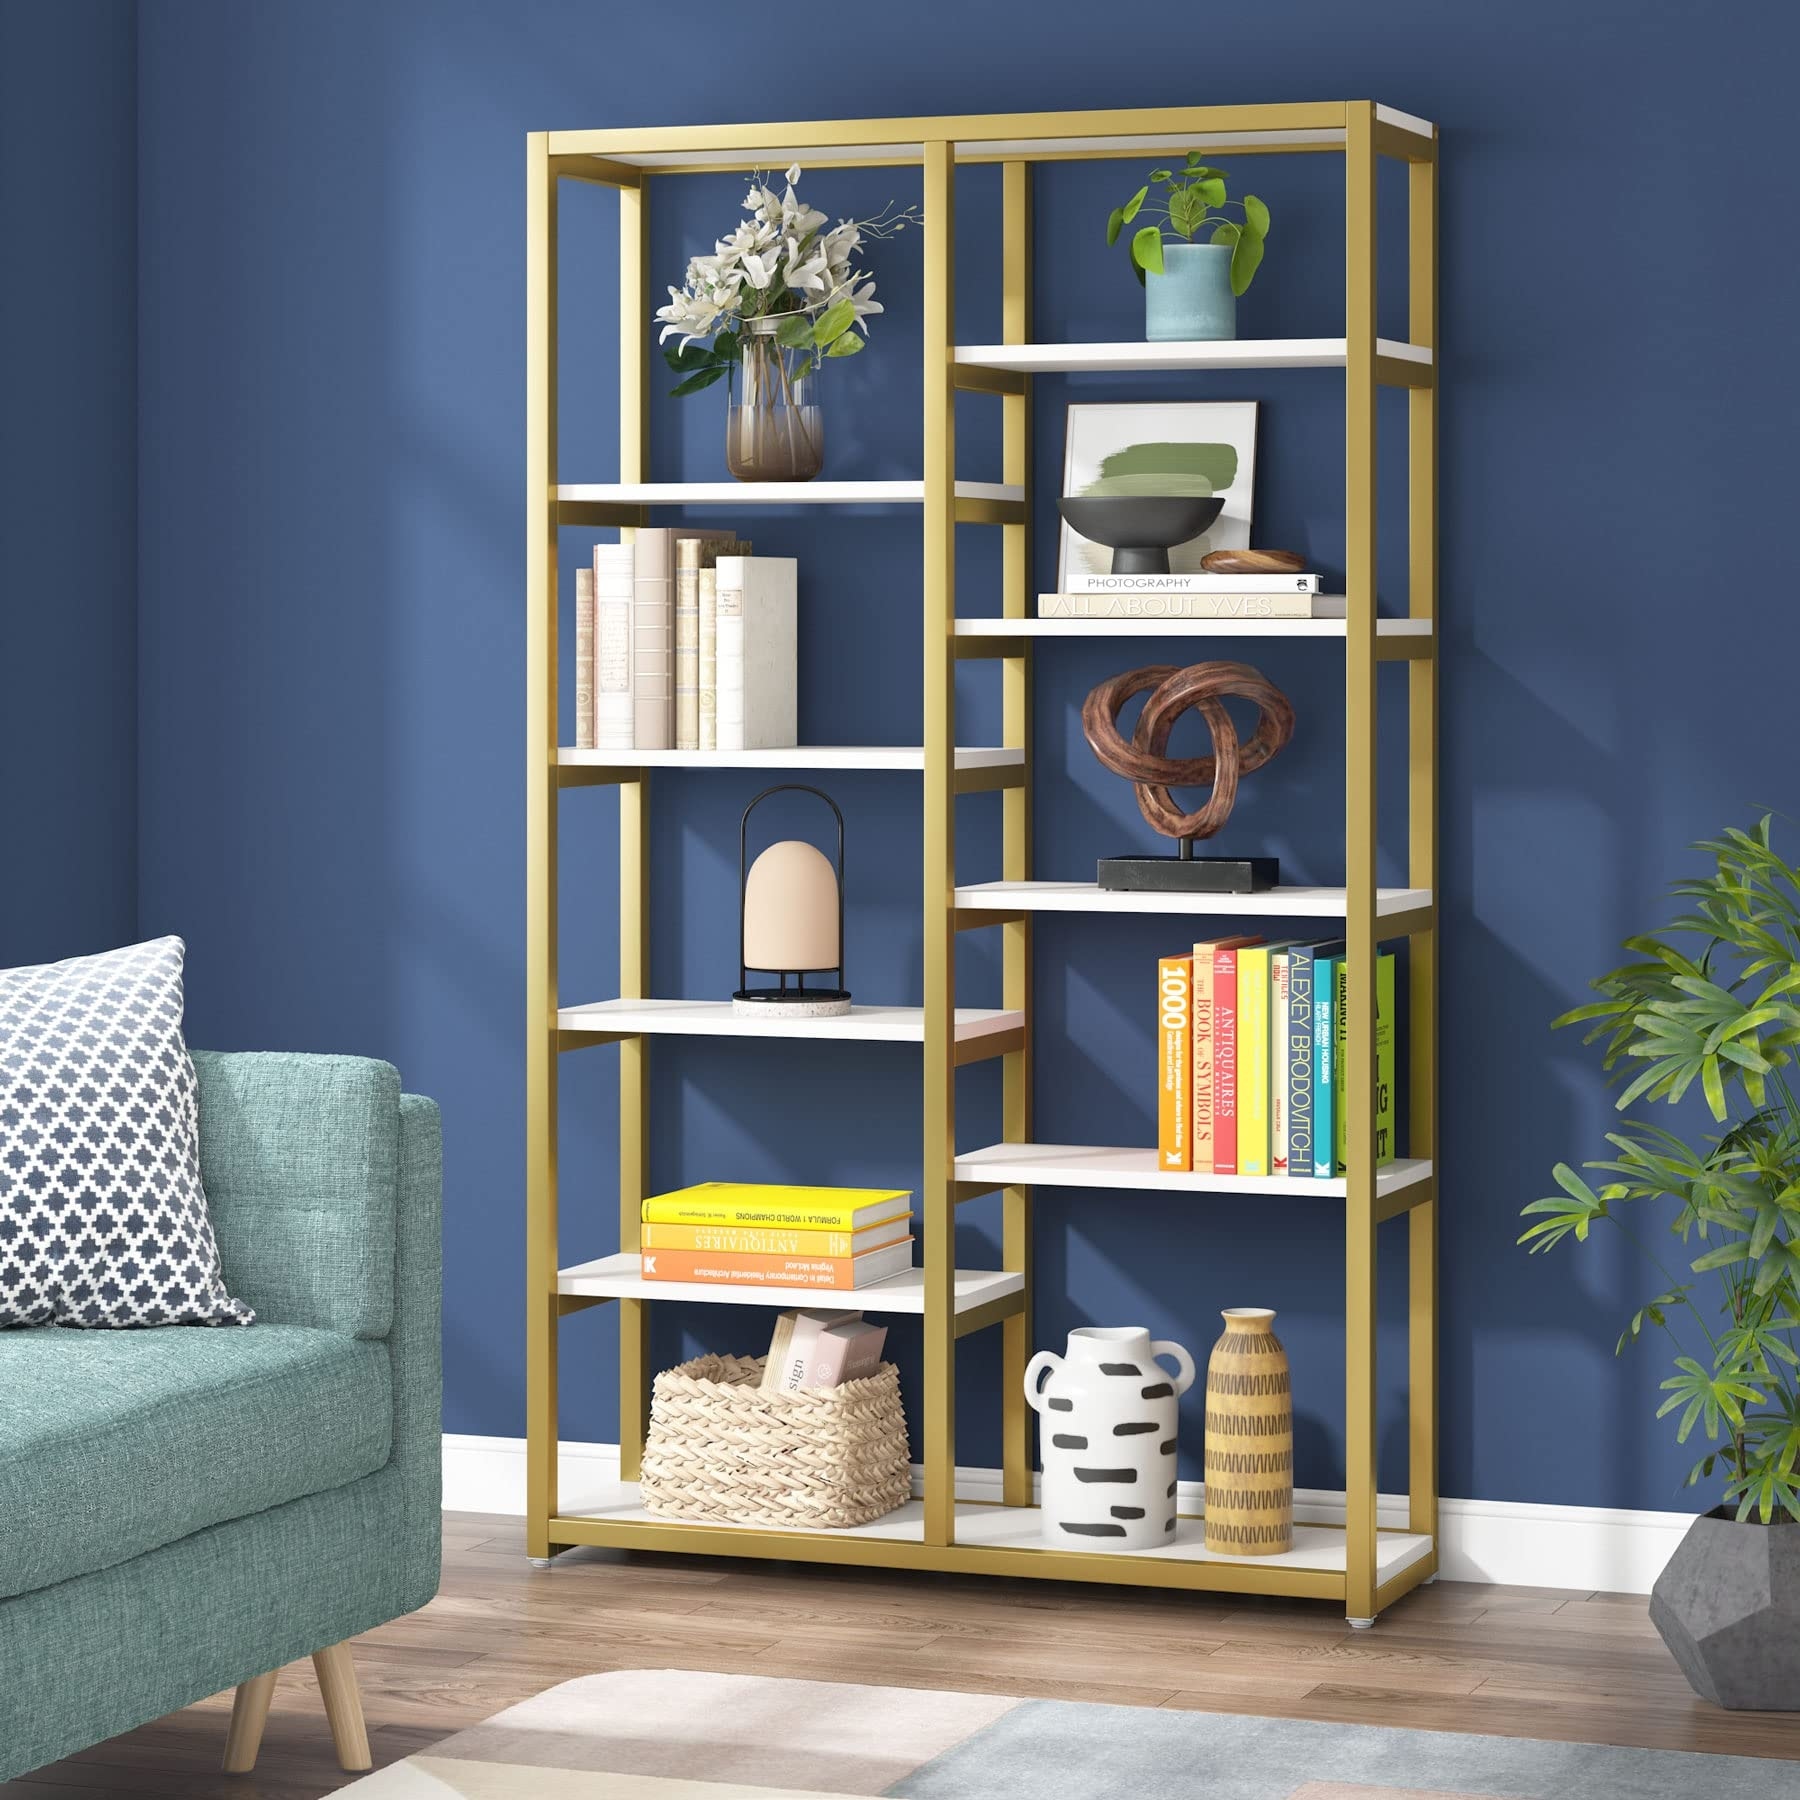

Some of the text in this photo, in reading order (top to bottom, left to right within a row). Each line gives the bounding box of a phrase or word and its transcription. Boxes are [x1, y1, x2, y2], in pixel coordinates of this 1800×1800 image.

[1088, 578, 1191, 589] PHOTOGRAPHY
[1050, 597, 1272, 617] ALL ABOUT YVES
[1161, 966, 1187, 1029] 1000
[1291, 952, 1311, 1030] ALEXEY
[1197, 999, 1211, 1043] BOOK
[1321, 1001, 1329, 1084] NEW URBAN HOUSING
[1219, 1007, 1235, 1117] ANTIQUAIRES
[1197, 1061, 1211, 1141] SYMBOLS
[1291, 1035, 1311, 1162] BRODOVITCH
[736, 1212, 775, 1222] CHAMPIONS
[776, 1214, 802, 1223] WORLD
[808, 1215, 841, 1225] FORMULA
[695, 1233, 798, 1252] ANTIQUAIRES
[766, 1272, 808, 1282] Contemporary
[788, 1359, 804, 1391] sign
